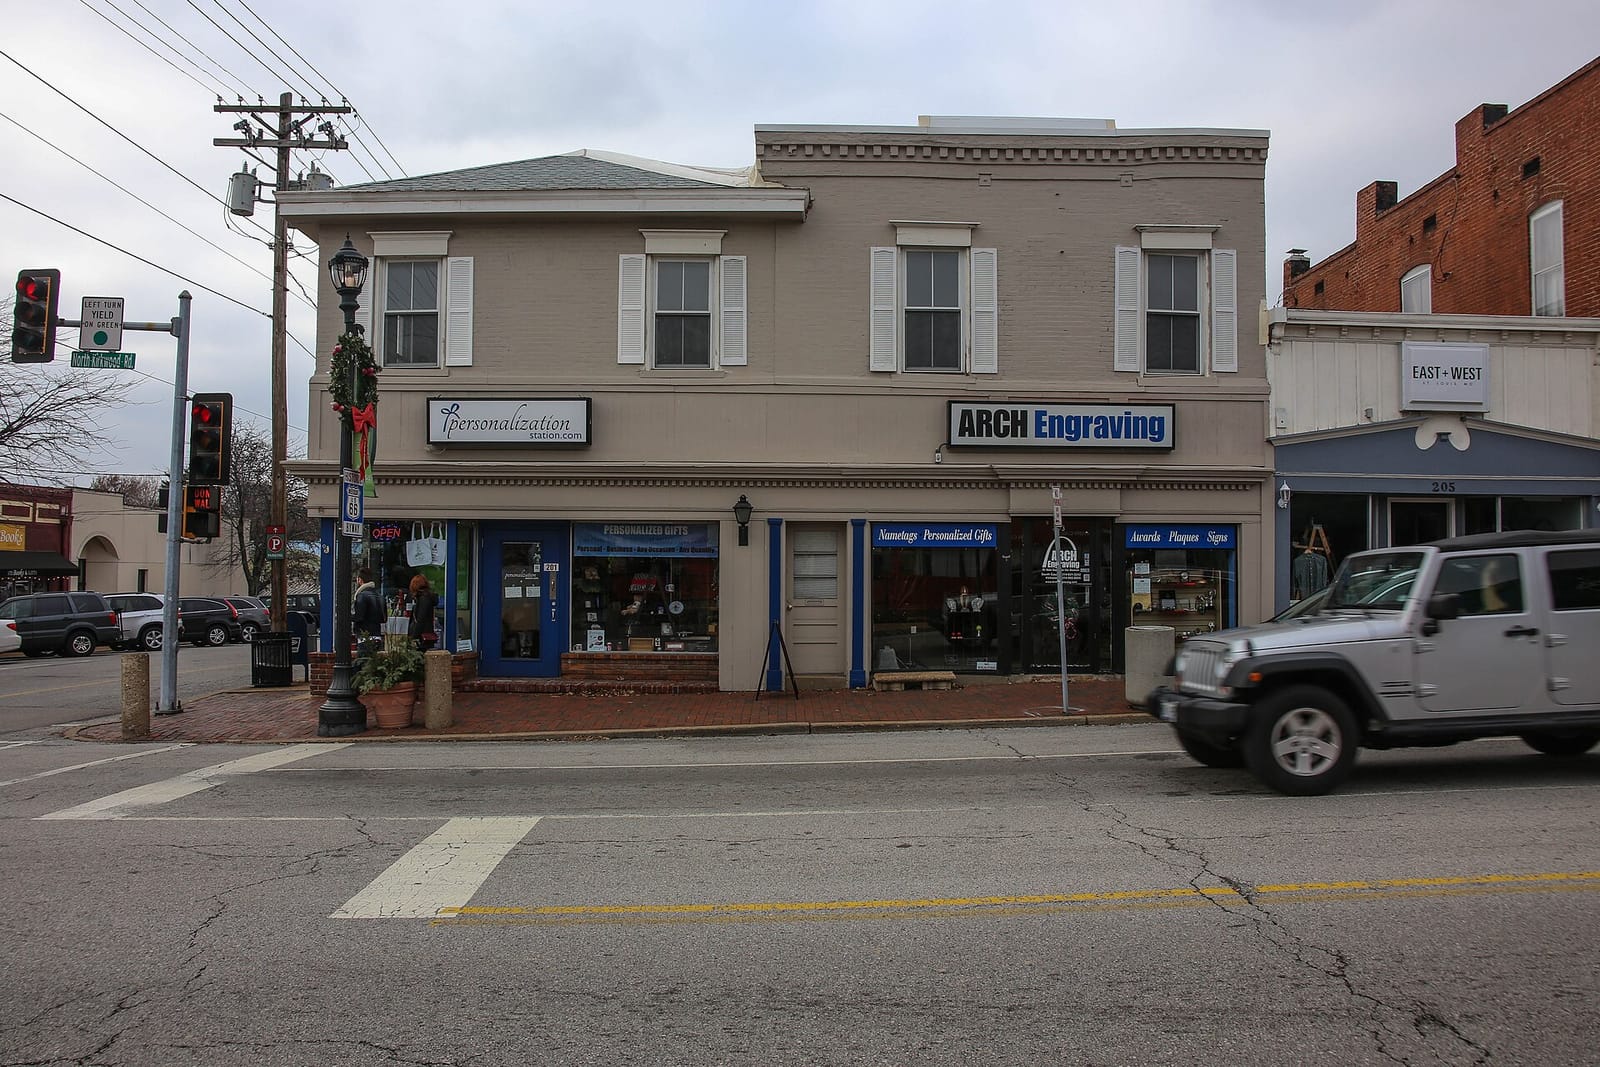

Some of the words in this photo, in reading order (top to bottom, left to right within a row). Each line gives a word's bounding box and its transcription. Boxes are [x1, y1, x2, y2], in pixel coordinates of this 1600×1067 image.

[84, 301, 100, 309] LEFT
[104, 301, 122, 309] TURN
[91, 310, 114, 320] YIELD
[97, 321, 119, 329] GREEN
[72, 352, 90, 367] North
[92, 352, 121, 368] Kirkwood
[1412, 365, 1441, 380] EAST
[1450, 366, 1482, 381] WEST
[448, 403, 570, 439] personalization
[957, 408, 1028, 438] ARCH
[1034, 409, 1165, 443] Engraving
[529, 431, 582, 440] station.com
[1431, 481, 1456, 492] 205
[194, 487, 211, 498] DON
[194, 499, 211, 509] WAL
[349, 503, 358, 516] 66
[372, 528, 401, 539] OPEN
[603, 524, 664, 536] PERSONALIZED
[664, 525, 689, 536] GIFTS
[0, 529, 23, 546] Books
[878, 529, 918, 544] Nametags
[923, 529, 973, 541] Personalized
[974, 529, 993, 544] Gifts
[1130, 530, 1161, 542] Awards
[1168, 530, 1200, 546] Plaques
[1206, 530, 1229, 546] Signs
[272, 538, 280, 550] P
[1051, 550, 1077, 561] ARCH
[1047, 560, 1080, 568] Engaving
